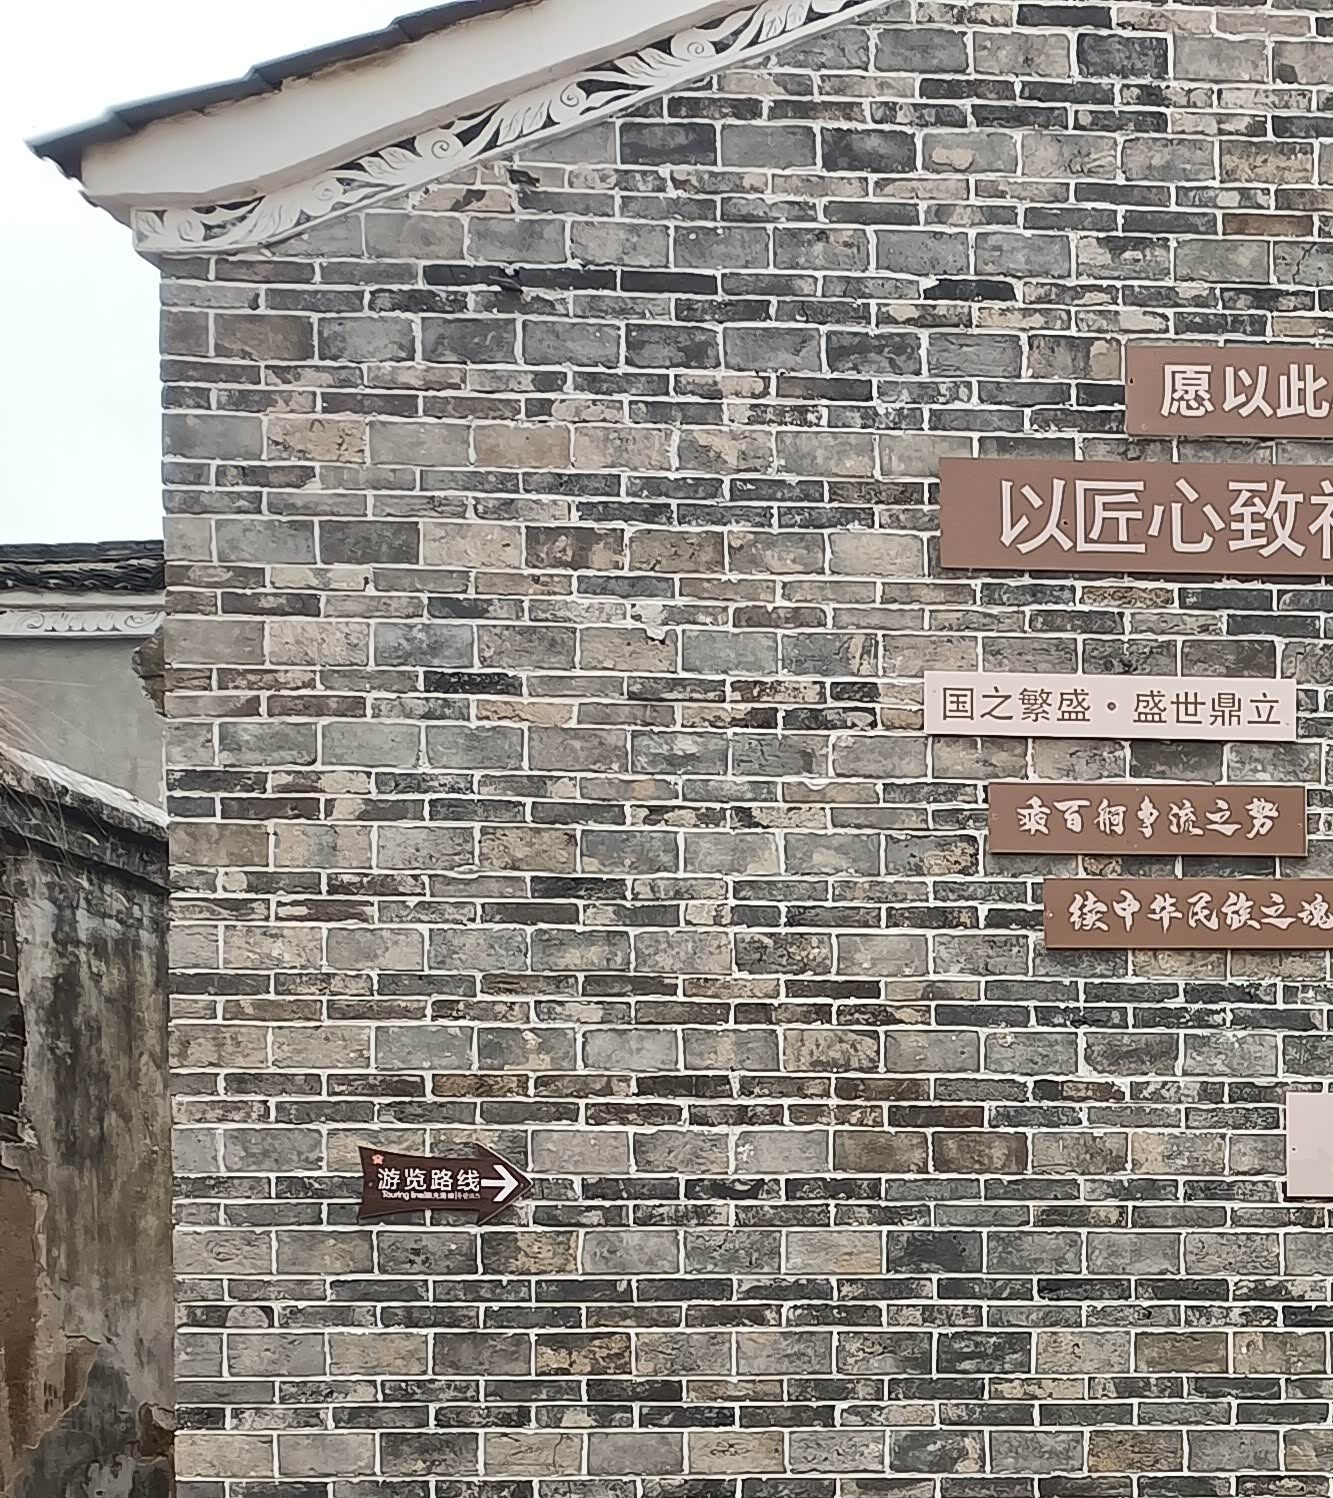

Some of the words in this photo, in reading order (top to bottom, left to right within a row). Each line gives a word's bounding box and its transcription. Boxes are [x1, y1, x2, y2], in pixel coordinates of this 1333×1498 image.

[941, 686, 1282, 727] 国之繁盛·盛世鼎立
[1016, 796, 1280, 840] 乘百舸争流之势
[377, 1168, 480, 1191] 游览路线
